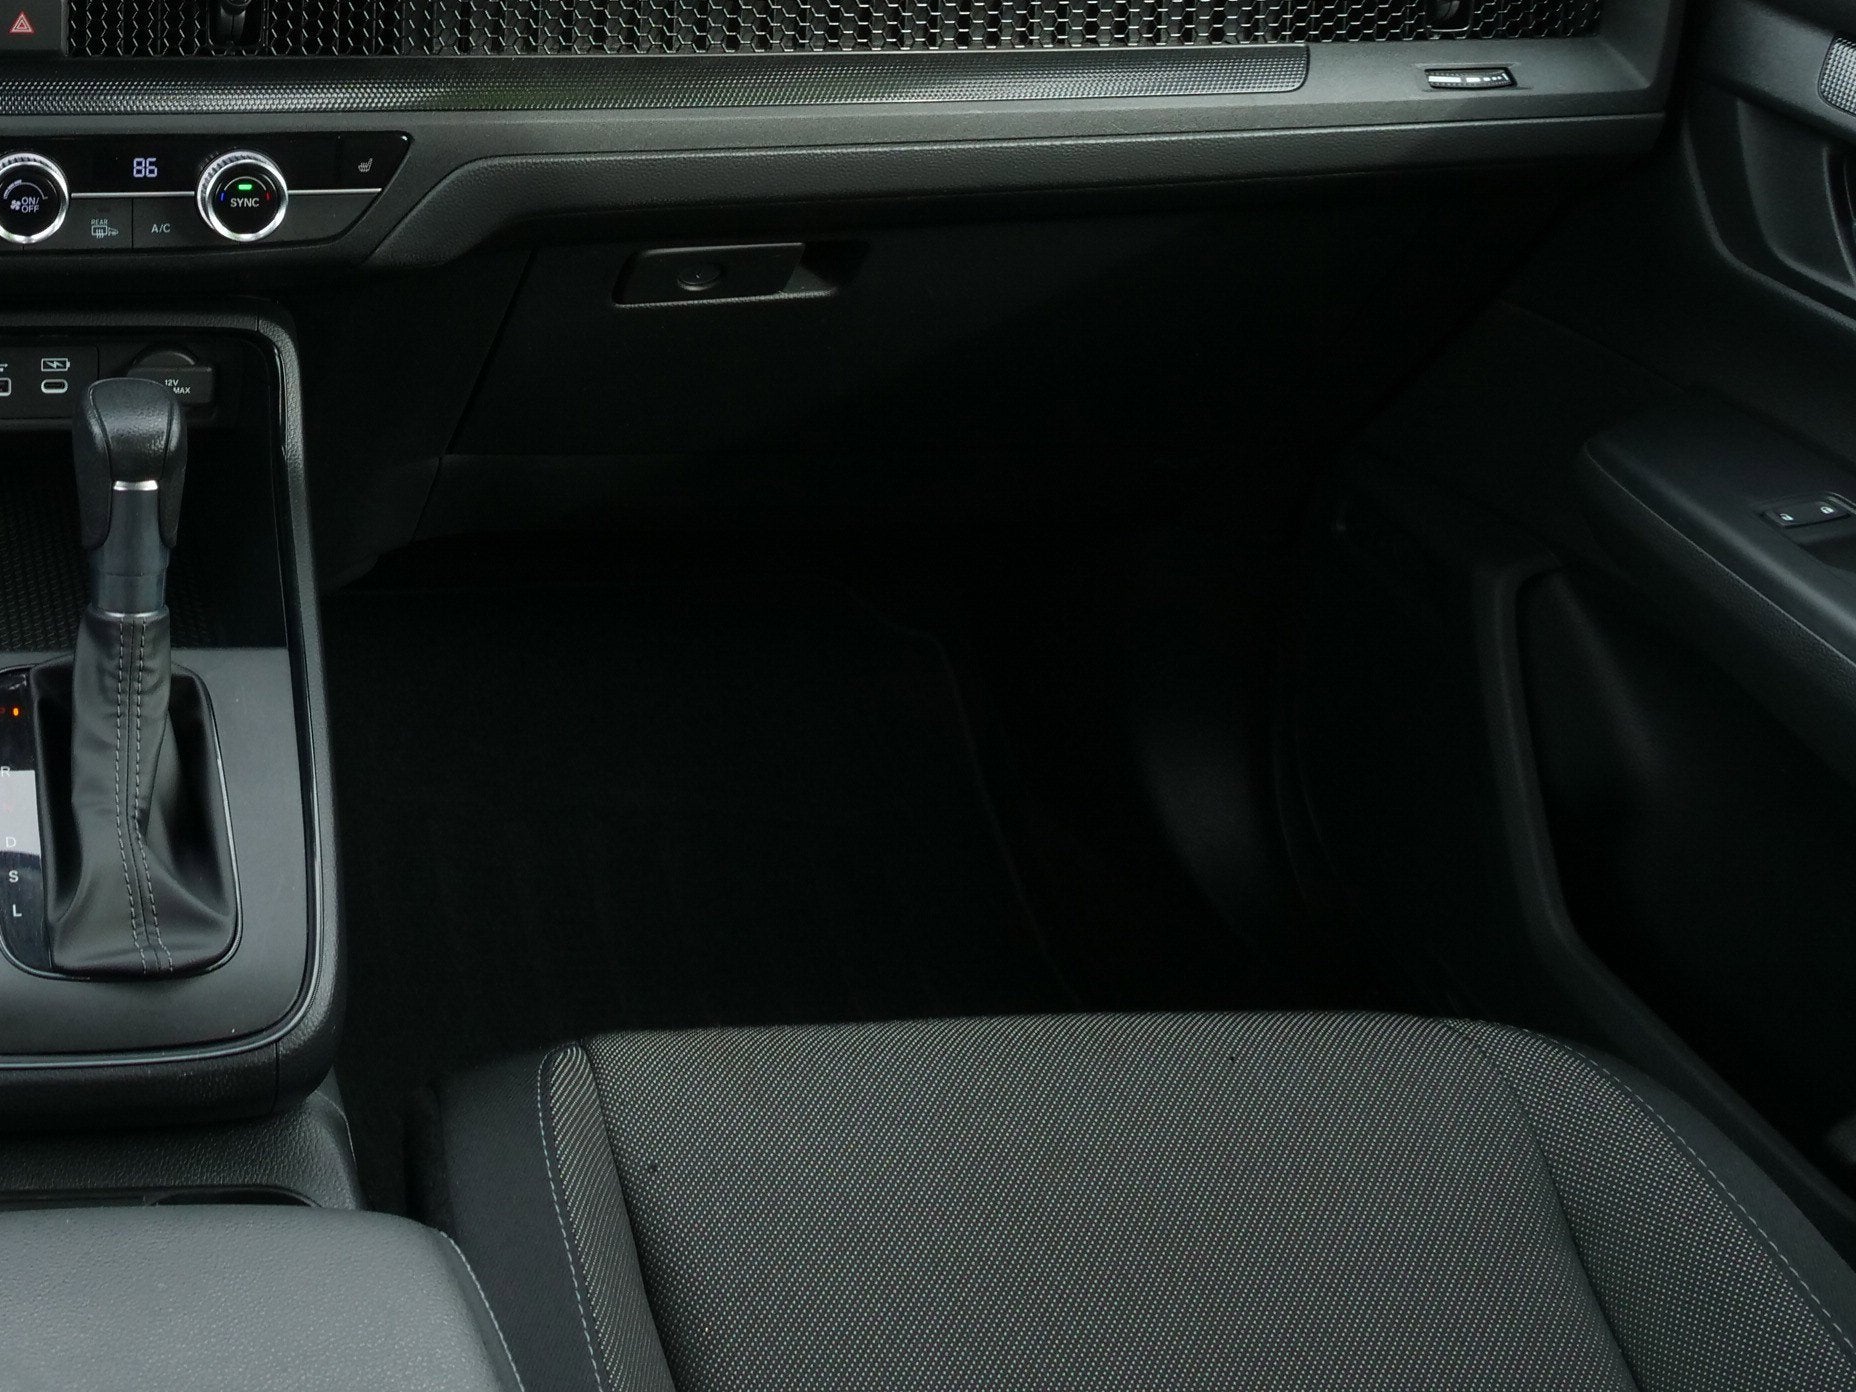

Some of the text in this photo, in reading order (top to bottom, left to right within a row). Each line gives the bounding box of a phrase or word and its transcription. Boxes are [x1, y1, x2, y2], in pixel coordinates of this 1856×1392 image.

[133, 157, 158, 178] 86
[21, 196, 40, 206] ON/
[230, 197, 260, 208] SYNC
[21, 205, 40, 214] OFF
[150, 223, 171, 234] A/C
[164, 378, 180, 387] 12V
[172, 386, 192, 395] MAX
[0, 765, 11, 777] R
[5, 835, 17, 848] D
[8, 869, 19, 883] S
[12, 903, 23, 918] L
